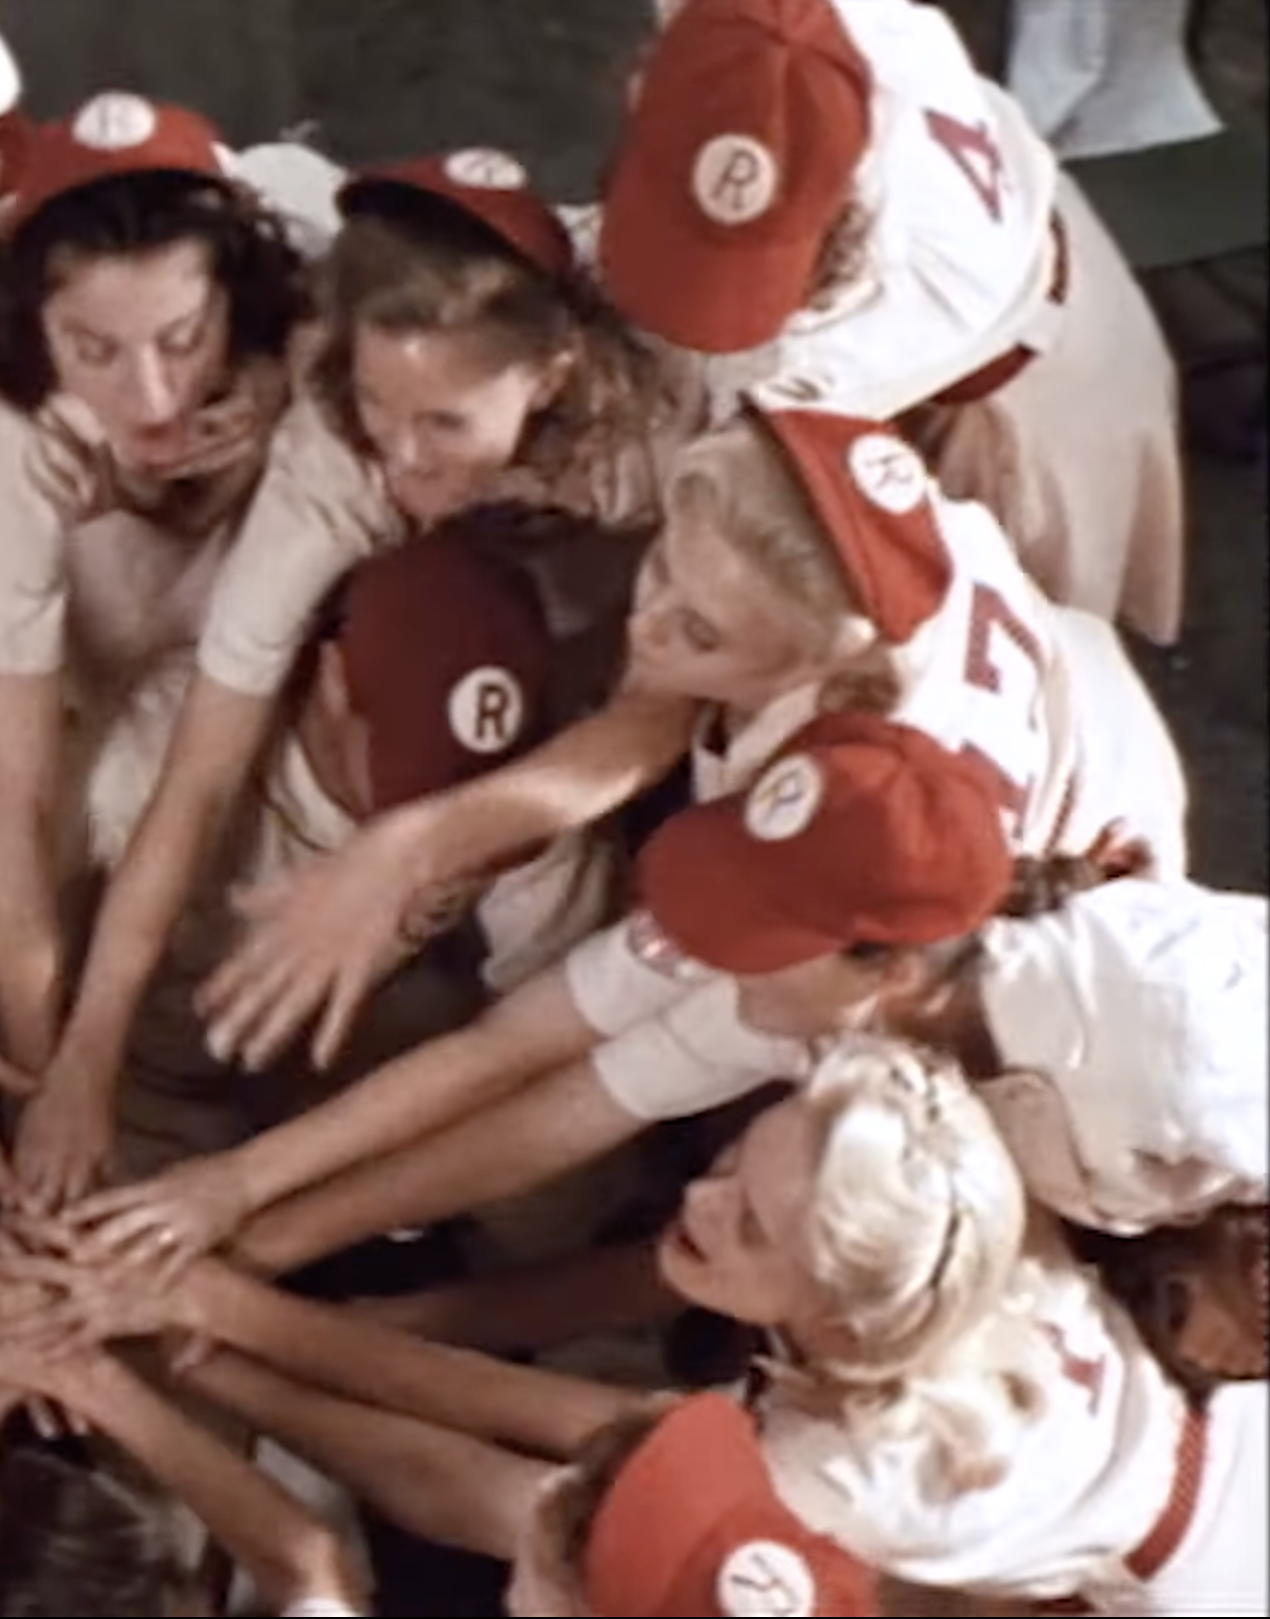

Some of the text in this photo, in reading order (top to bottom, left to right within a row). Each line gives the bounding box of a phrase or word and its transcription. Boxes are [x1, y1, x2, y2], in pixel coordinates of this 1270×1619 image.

[711, 148, 759, 211] R
[922, 106, 1014, 222] 4
[475, 682, 510, 740] R
[759, 766, 806, 826] R
